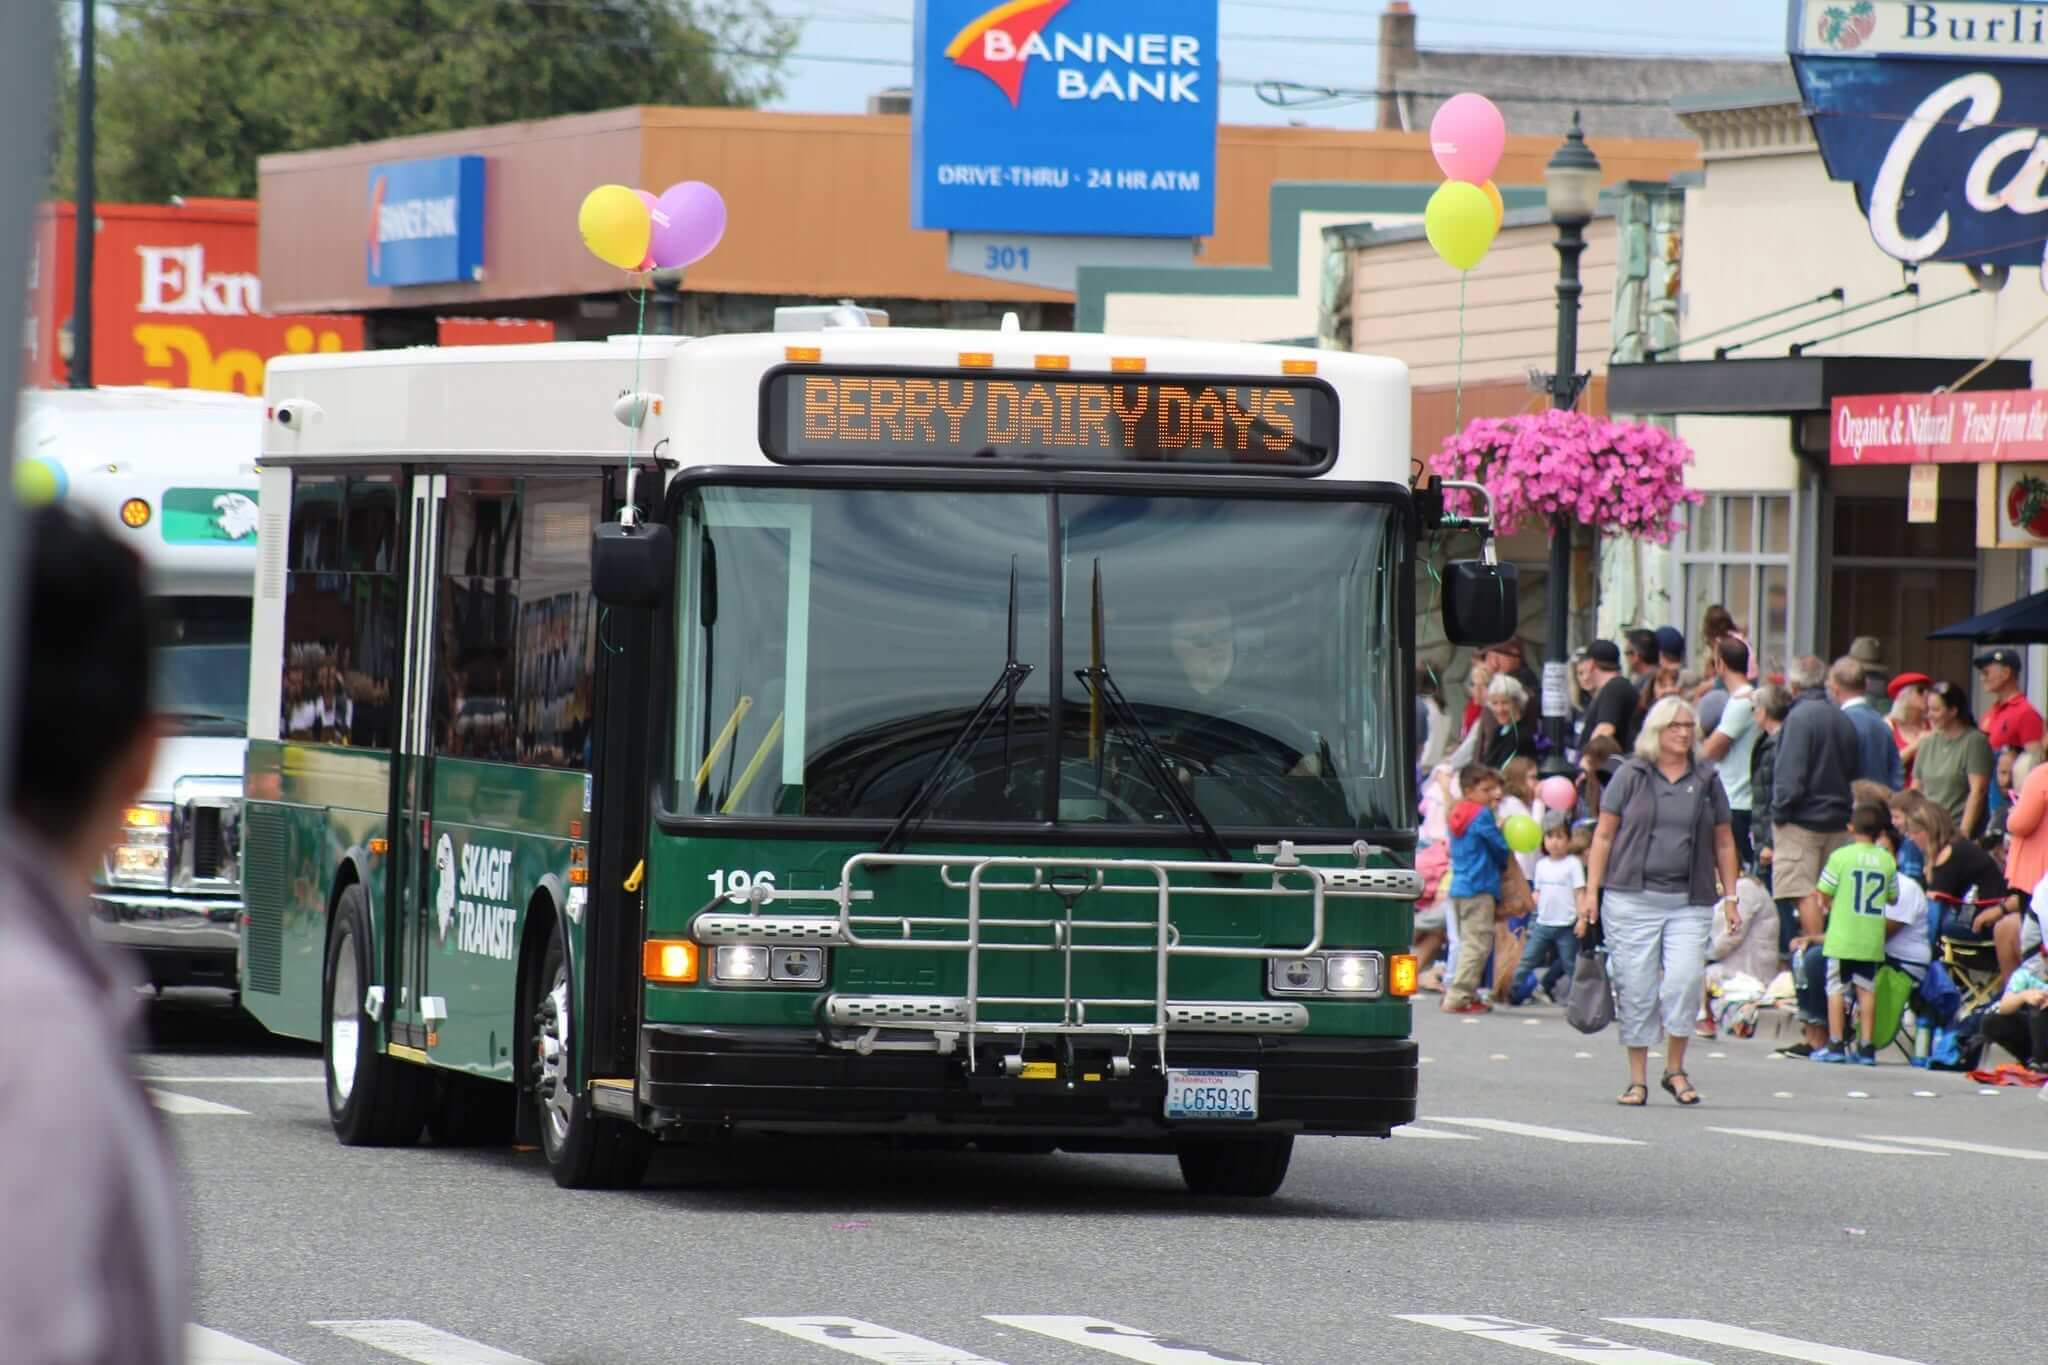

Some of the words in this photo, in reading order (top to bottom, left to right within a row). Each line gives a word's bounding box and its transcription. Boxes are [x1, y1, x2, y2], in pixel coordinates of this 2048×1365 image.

[1900, 2, 2048, 44] Burli
[983, 29, 1200, 66] BANNER
[1057, 69, 1200, 103] BANK
[1087, 168, 1112, 189] 24
[1117, 170, 1148, 190] HR
[1150, 170, 1200, 191] ATM
[985, 245, 1030, 270] 301
[805, 378, 974, 444] BERRY
[987, 381, 1149, 448] DAIRY
[1158, 386, 1296, 450] DAYS
[1838, 404, 1890, 460] Organic
[1891, 405, 1904, 445] &
[1905, 401, 1954, 446] Natural
[460, 843, 512, 901] SKAGIT
[707, 869, 776, 905] 196
[1852, 870, 1885, 915] 12
[458, 900, 517, 960] TRANSIT
[1183, 1088, 1252, 1110] C6593C
